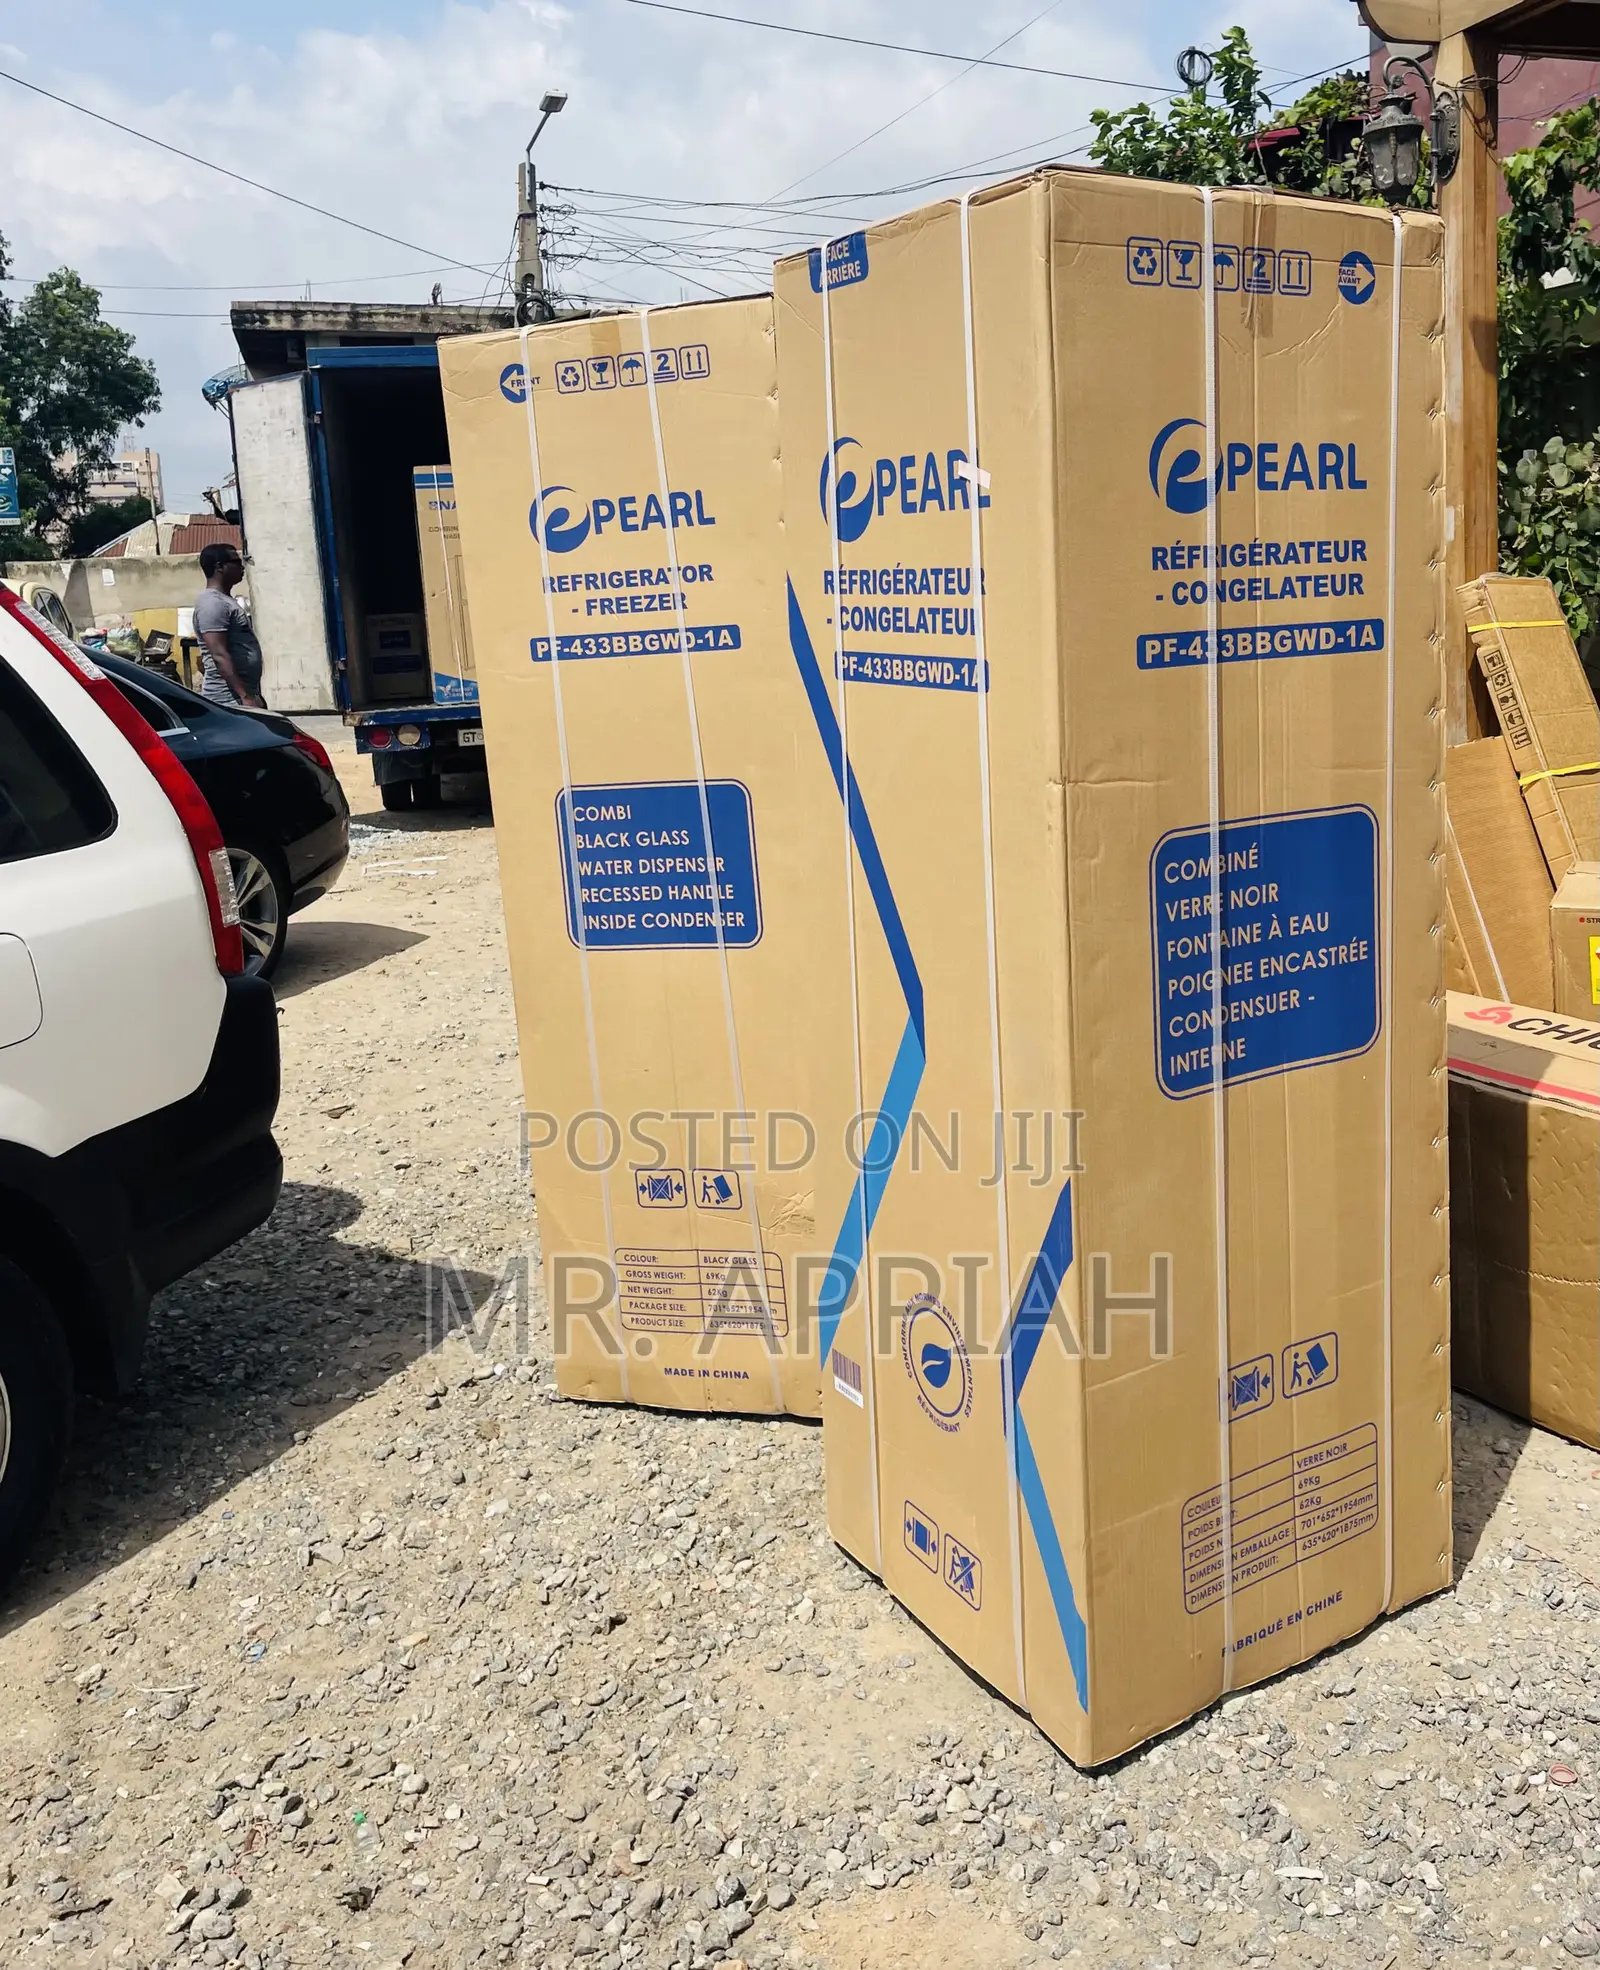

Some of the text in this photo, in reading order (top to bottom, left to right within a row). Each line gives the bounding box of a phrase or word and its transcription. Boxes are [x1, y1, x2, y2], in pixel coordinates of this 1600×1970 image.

[827, 241, 850, 263] FACE
[1338, 277, 1361, 285] AVANT
[1339, 268, 1356, 276] FACE
[1227, 442, 1368, 492] PEARL
[592, 489, 716, 535] PEARL
[1151, 537, 1368, 571] RÉFRIGÉRATEUR
[1171, 573, 1365, 606] CONGELATEUR
[585, 592, 689, 617] FREEZER
[573, 804, 632, 822] COMBI
[576, 829, 690, 849] BLACK GLASS
[578, 856, 726, 877] WATER DISPENSR
[1164, 842, 1259, 884] COMBINÉ
[581, 885, 663, 903] RECESSED
[1230, 882, 1279, 911] NOIR
[583, 913, 637, 930] INSIDE
[1268, 913, 1283, 941] À
[1289, 911, 1330, 937] EAU
[1168, 936, 1369, 1000] POIGNEE ENCASTRÉE
[1169, 988, 1301, 1038] CONDENSUER
[1170, 1036, 1247, 1077] INTENE
[623, 1254, 758, 1266] COLOUR: BLACK GLASS
[626, 1270, 726, 1282] GROSS WEIGHT: 69Kg
[627, 1285, 728, 1297] NET WEIGHT: 62Kg
[629, 1301, 777, 1315] PACKAGE SIZE: 7016521954m
[630, 1317, 780, 1331] PRODUCT SIZE: 6356201875m
[664, 1367, 750, 1380] MADE IN CHINA
[1296, 1452, 1325, 1469] VERRE
[1326, 1443, 1348, 1459] NOIR
[1188, 1520, 1214, 1540] POIDS
[1298, 1475, 1321, 1490] 69Kg
[1189, 1541, 1215, 1562] POIDS
[1299, 1496, 1322, 1510] 62Kg
[1190, 1552, 1238, 1583] DIMENSIN
[1240, 1528, 1290, 1558] EMBALLAGE
[1190, 1573, 1239, 1605] DIMENSIN
[1241, 1555, 1279, 1580] PRODUIT:
[1287, 1609, 1303, 1626] EN
[1306, 1590, 1343, 1617] CHINE
